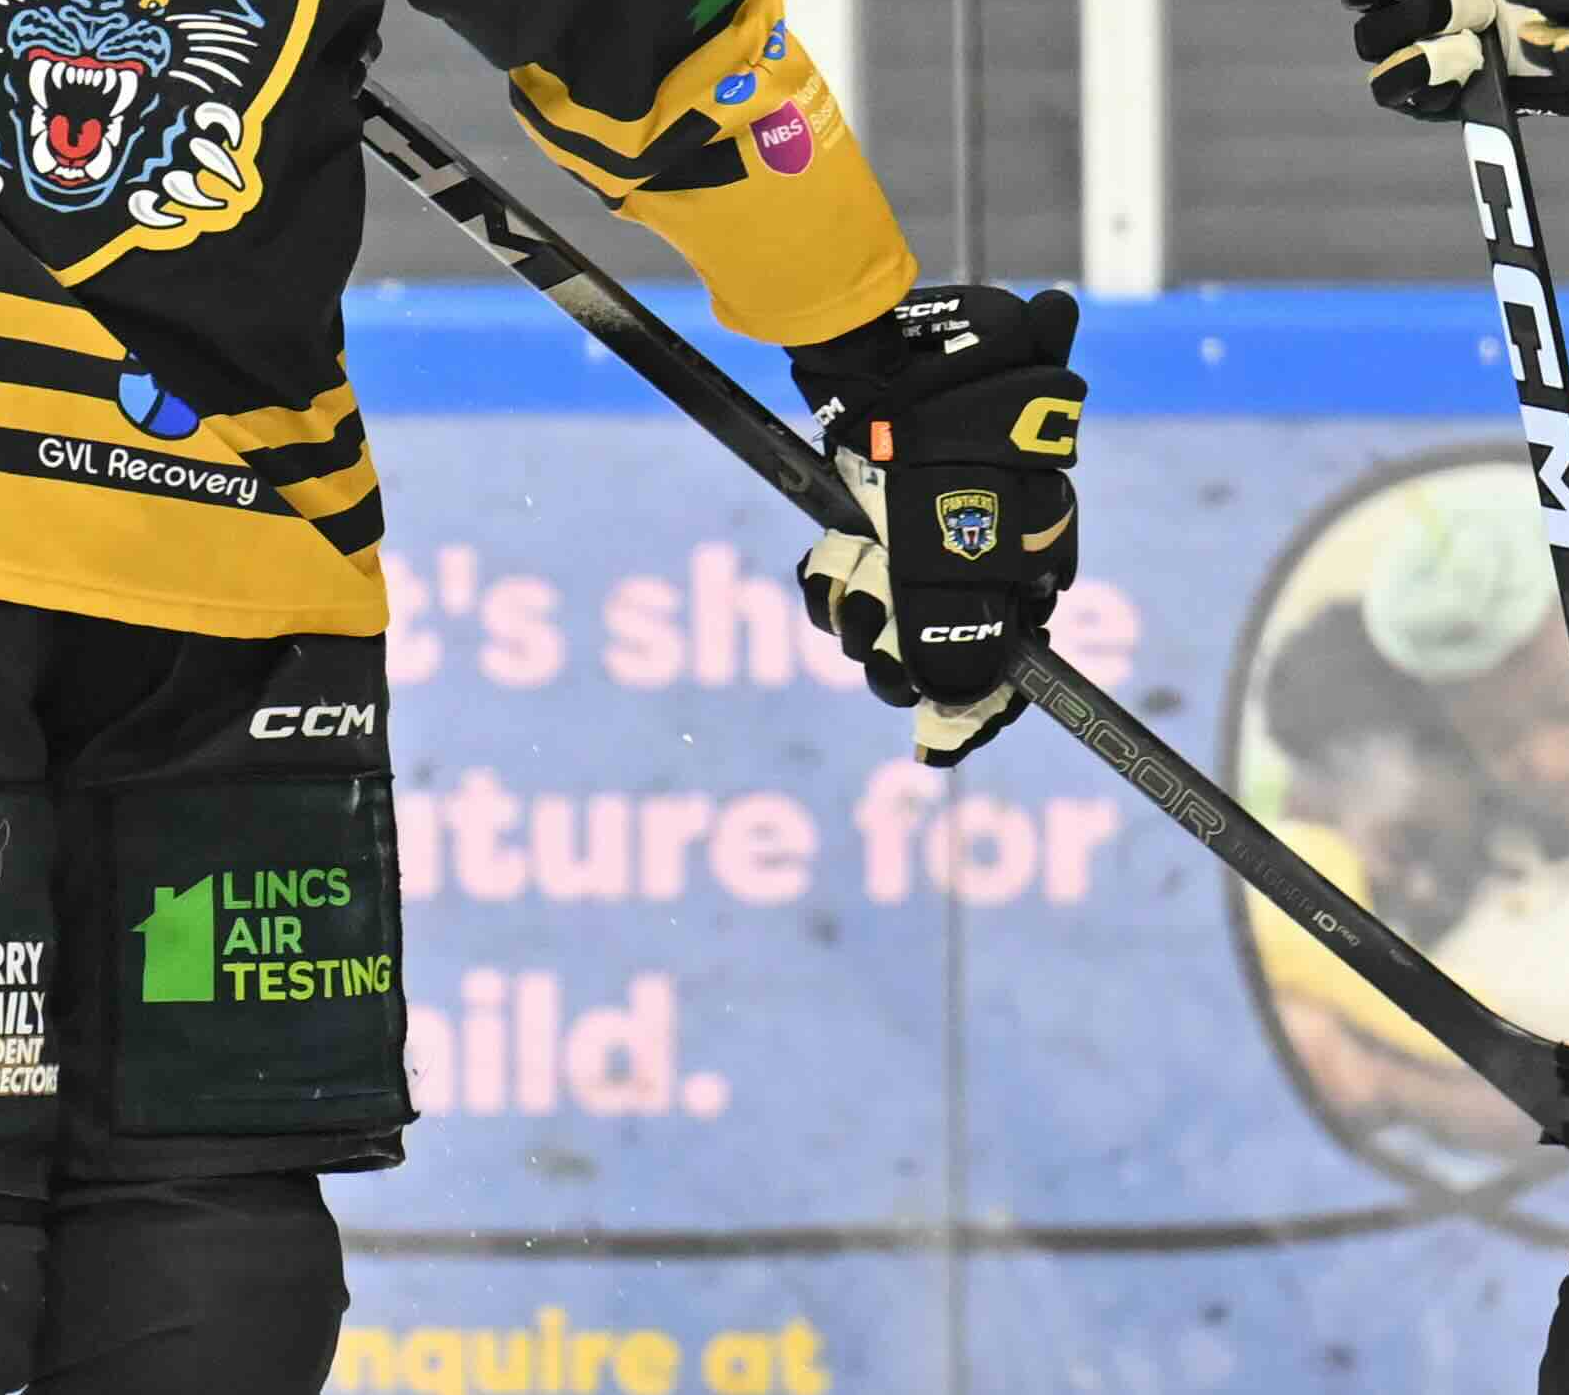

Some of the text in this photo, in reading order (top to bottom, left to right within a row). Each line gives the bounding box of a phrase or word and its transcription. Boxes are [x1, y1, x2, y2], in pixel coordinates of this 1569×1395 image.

[761, 117, 805, 149] NBS
[37, 436, 259, 507] GVL Recovery
[920, 620, 1004, 644] CCM
[248, 703, 377, 741] CCM
[402, 758, 1121, 905] ture for
[221, 866, 352, 912] LINCS
[221, 916, 304, 957] AIR
[221, 955, 393, 1003] TESTING
